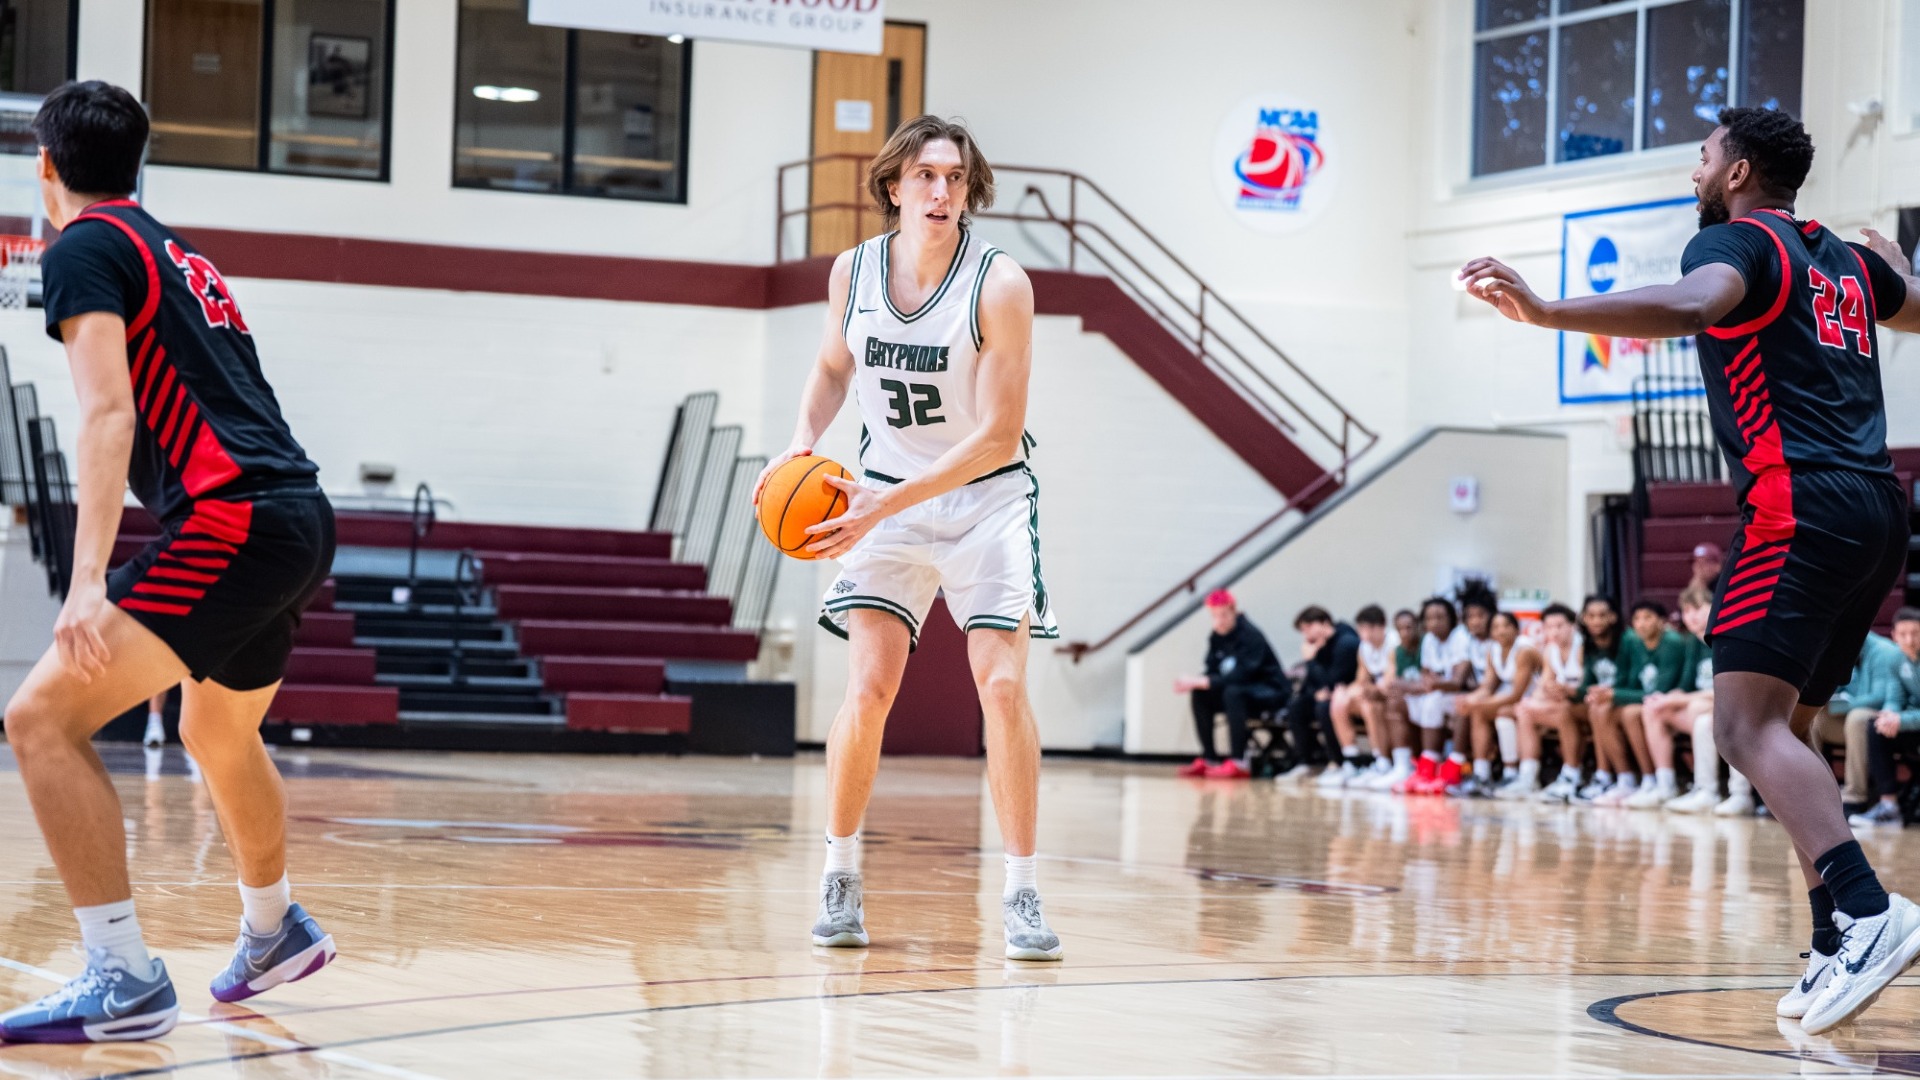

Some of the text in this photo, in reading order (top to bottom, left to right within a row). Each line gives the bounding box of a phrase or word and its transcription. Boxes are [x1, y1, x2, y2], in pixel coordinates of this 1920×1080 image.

[648, 0, 777, 26] INSURANCE
[787, 10, 864, 33] GROUP
[1808, 265, 1872, 358] 24
[864, 335, 950, 373] GRYPHONS
[880, 377, 947, 429] 32
